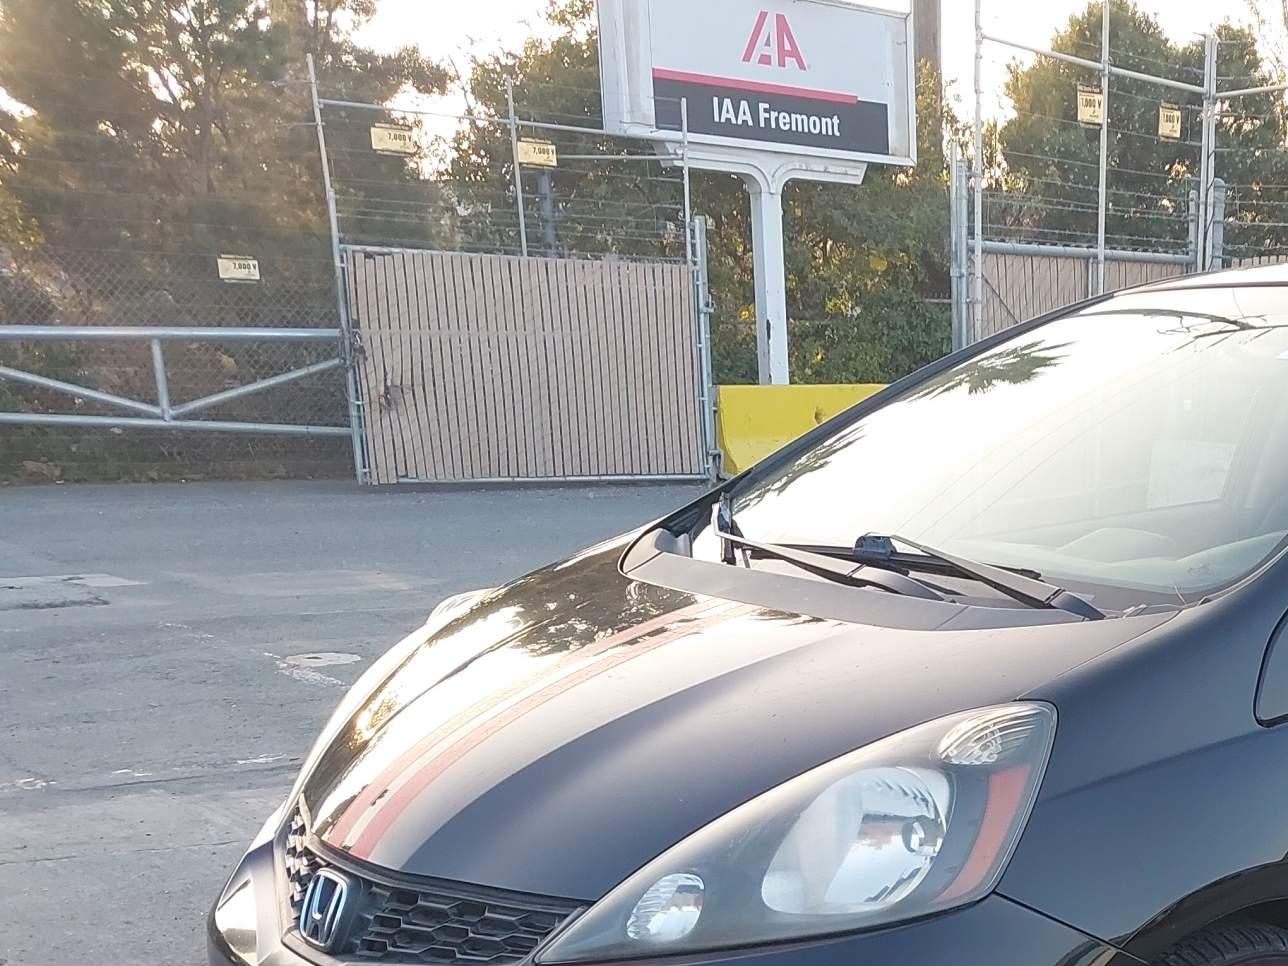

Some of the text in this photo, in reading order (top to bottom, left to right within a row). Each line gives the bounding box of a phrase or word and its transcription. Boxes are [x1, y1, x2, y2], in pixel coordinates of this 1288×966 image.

[713, 96, 840, 137] IAA Fremont
[388, 132, 407, 141] 7,000
